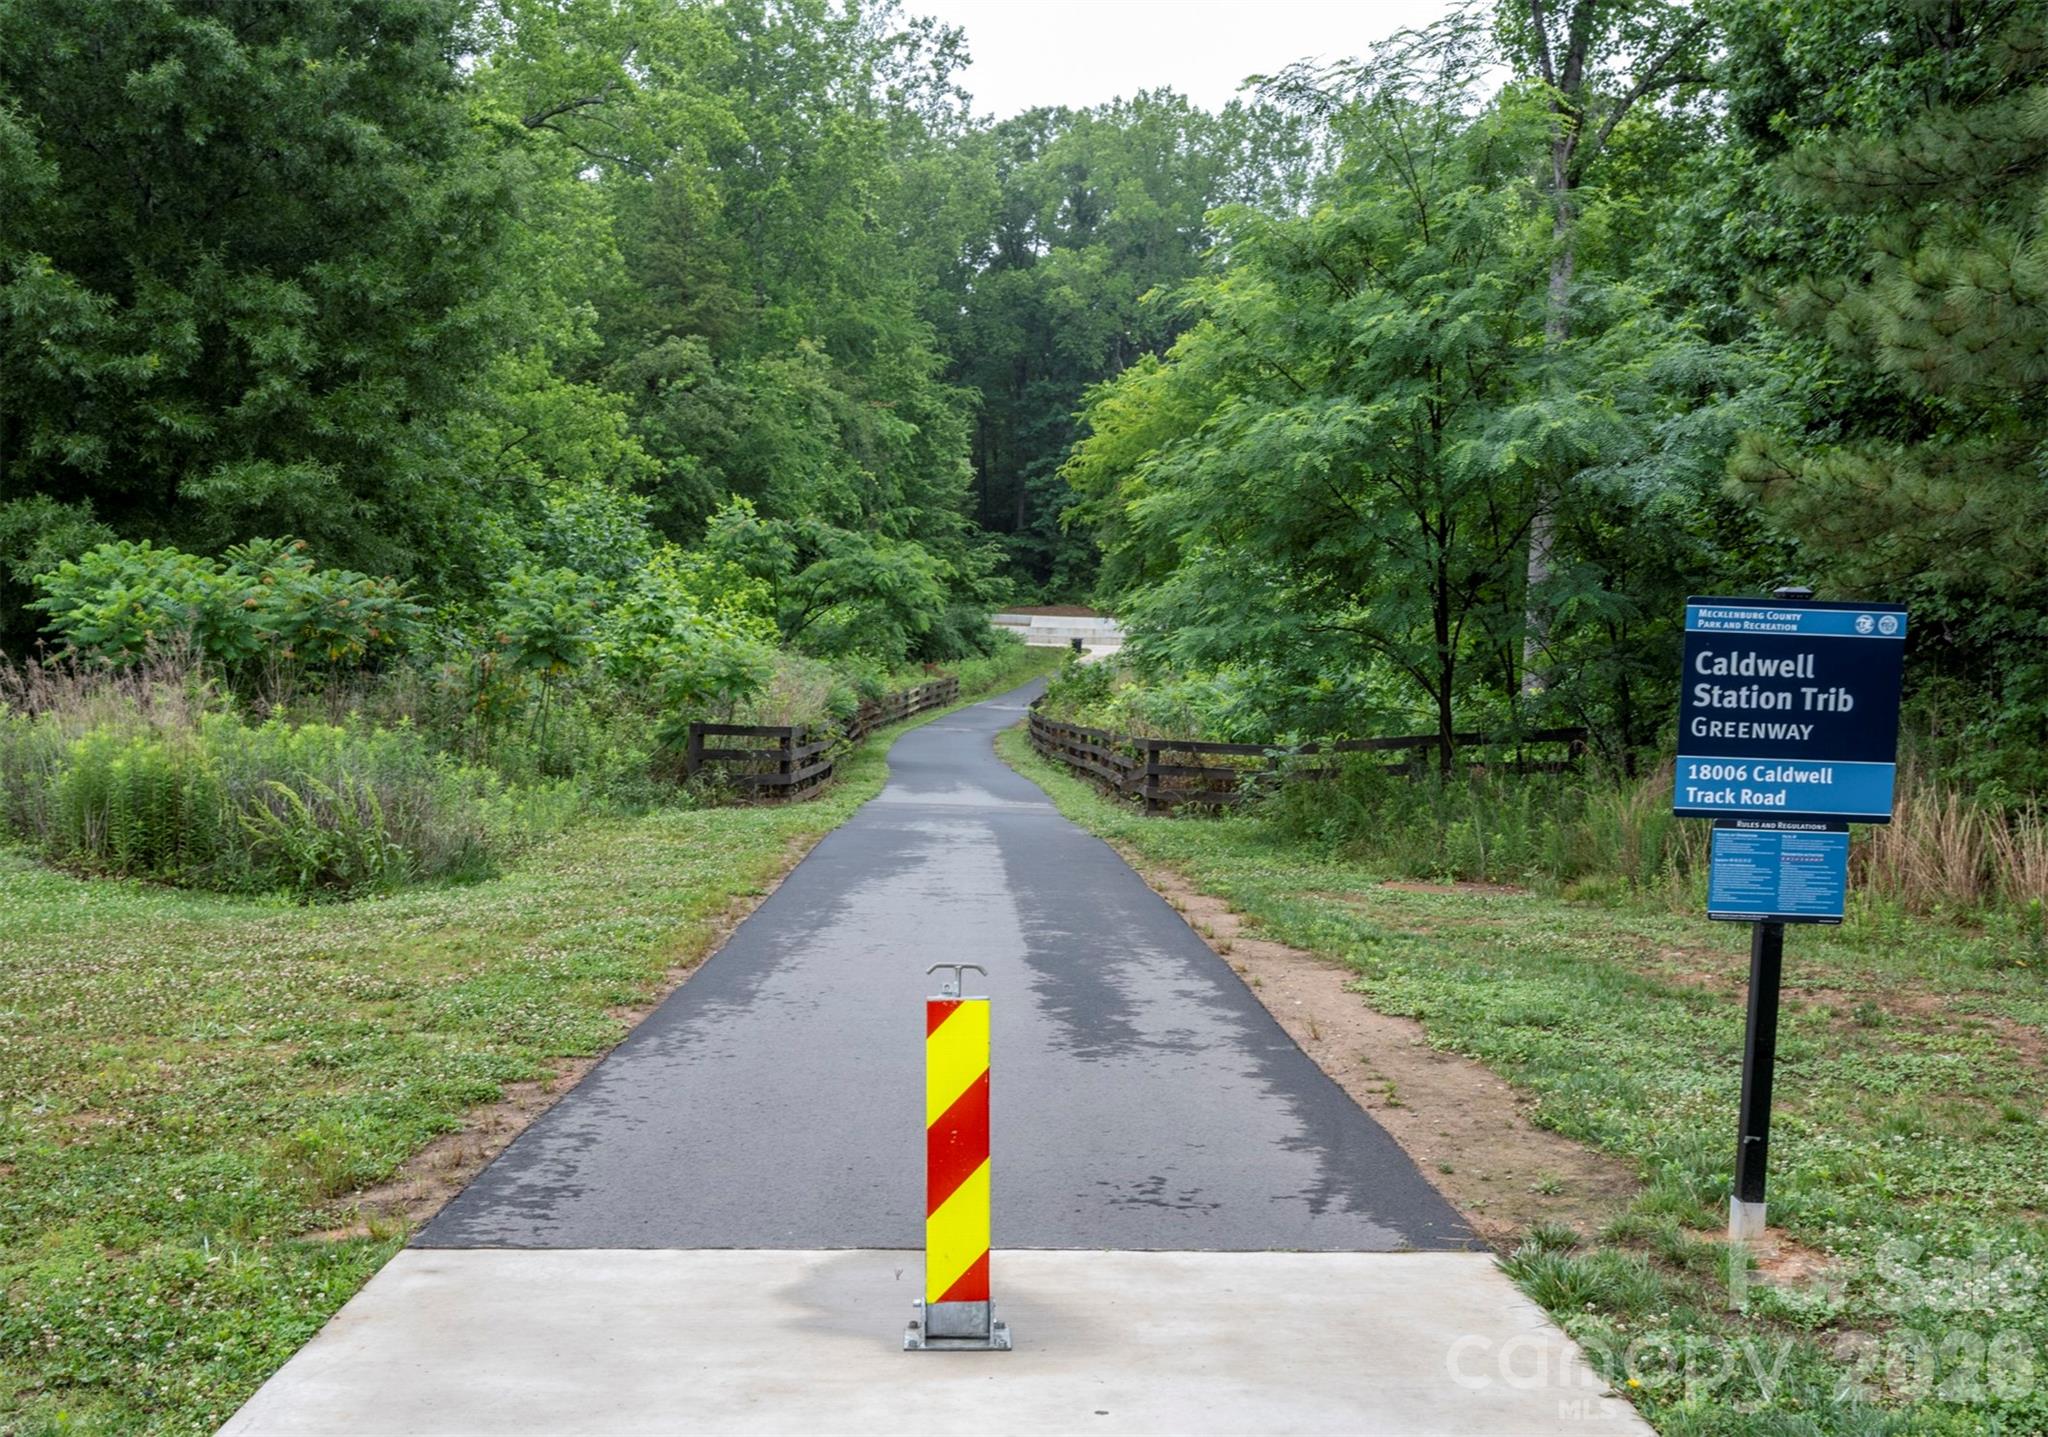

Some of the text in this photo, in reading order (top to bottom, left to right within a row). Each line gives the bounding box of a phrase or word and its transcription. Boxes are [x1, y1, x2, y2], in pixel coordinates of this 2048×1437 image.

[1698, 608, 1802, 622] MECKLENBURG COUNTY
[1697, 619, 1798, 632] PARK AND RECREATION
[1695, 651, 1815, 679] Caldwell
[1692, 683, 1854, 712] Station Trib
[1691, 716, 1814, 740] GREENWAY
[1688, 764, 1833, 784] 18006 Caldwell
[1686, 787, 1787, 806] Track Road
[1736, 820, 1760, 829] RULES
[1777, 821, 1828, 831] REGULATIONS
